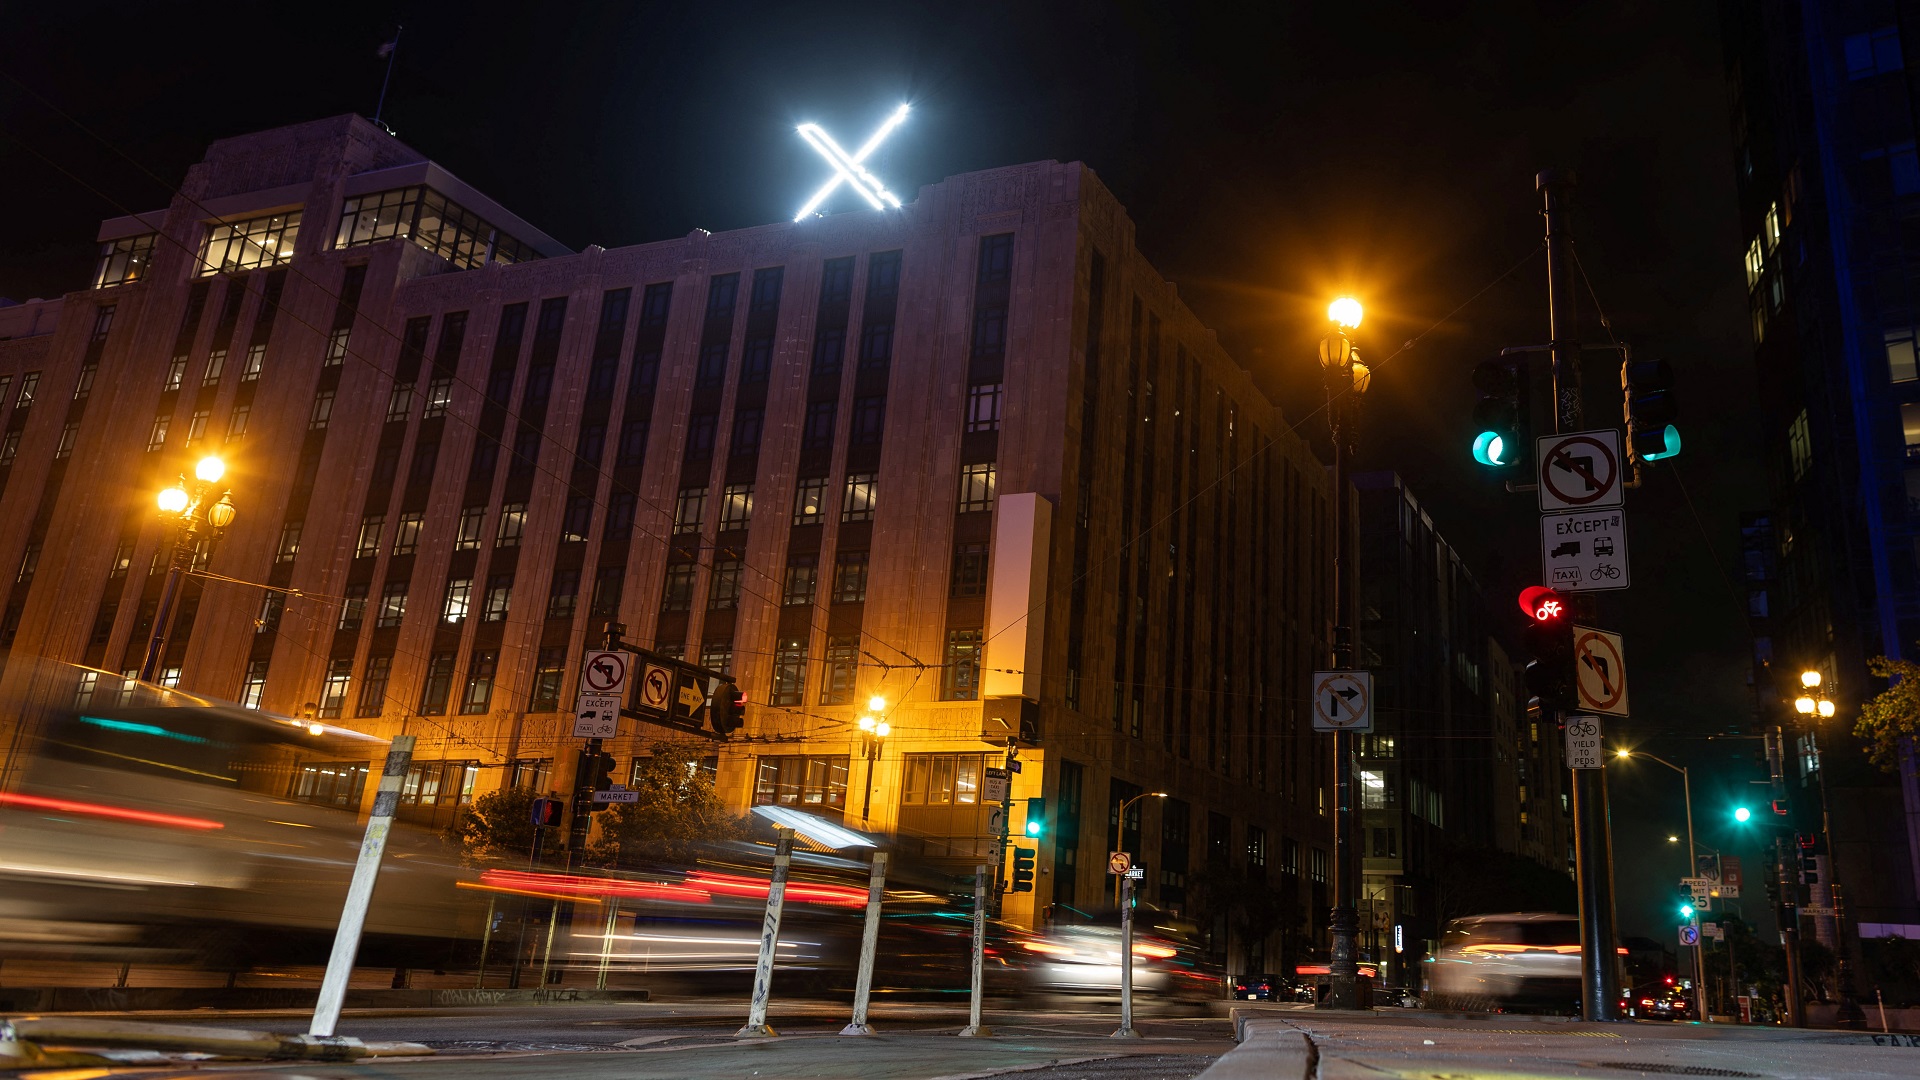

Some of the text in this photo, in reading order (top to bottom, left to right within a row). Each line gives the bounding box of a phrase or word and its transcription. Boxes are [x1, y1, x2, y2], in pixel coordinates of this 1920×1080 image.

[795, 103, 908, 222] X
[1556, 519, 1609, 535] EXCEPT
[1555, 571, 1578, 580] TAXI
[680, 691, 703, 703] ONE WAY
[585, 699, 614, 708] EXCEPT
[1572, 740, 1595, 748] YIELD
[1574, 757, 1595, 765] PEDS
[600, 793, 633, 801] MARKET
